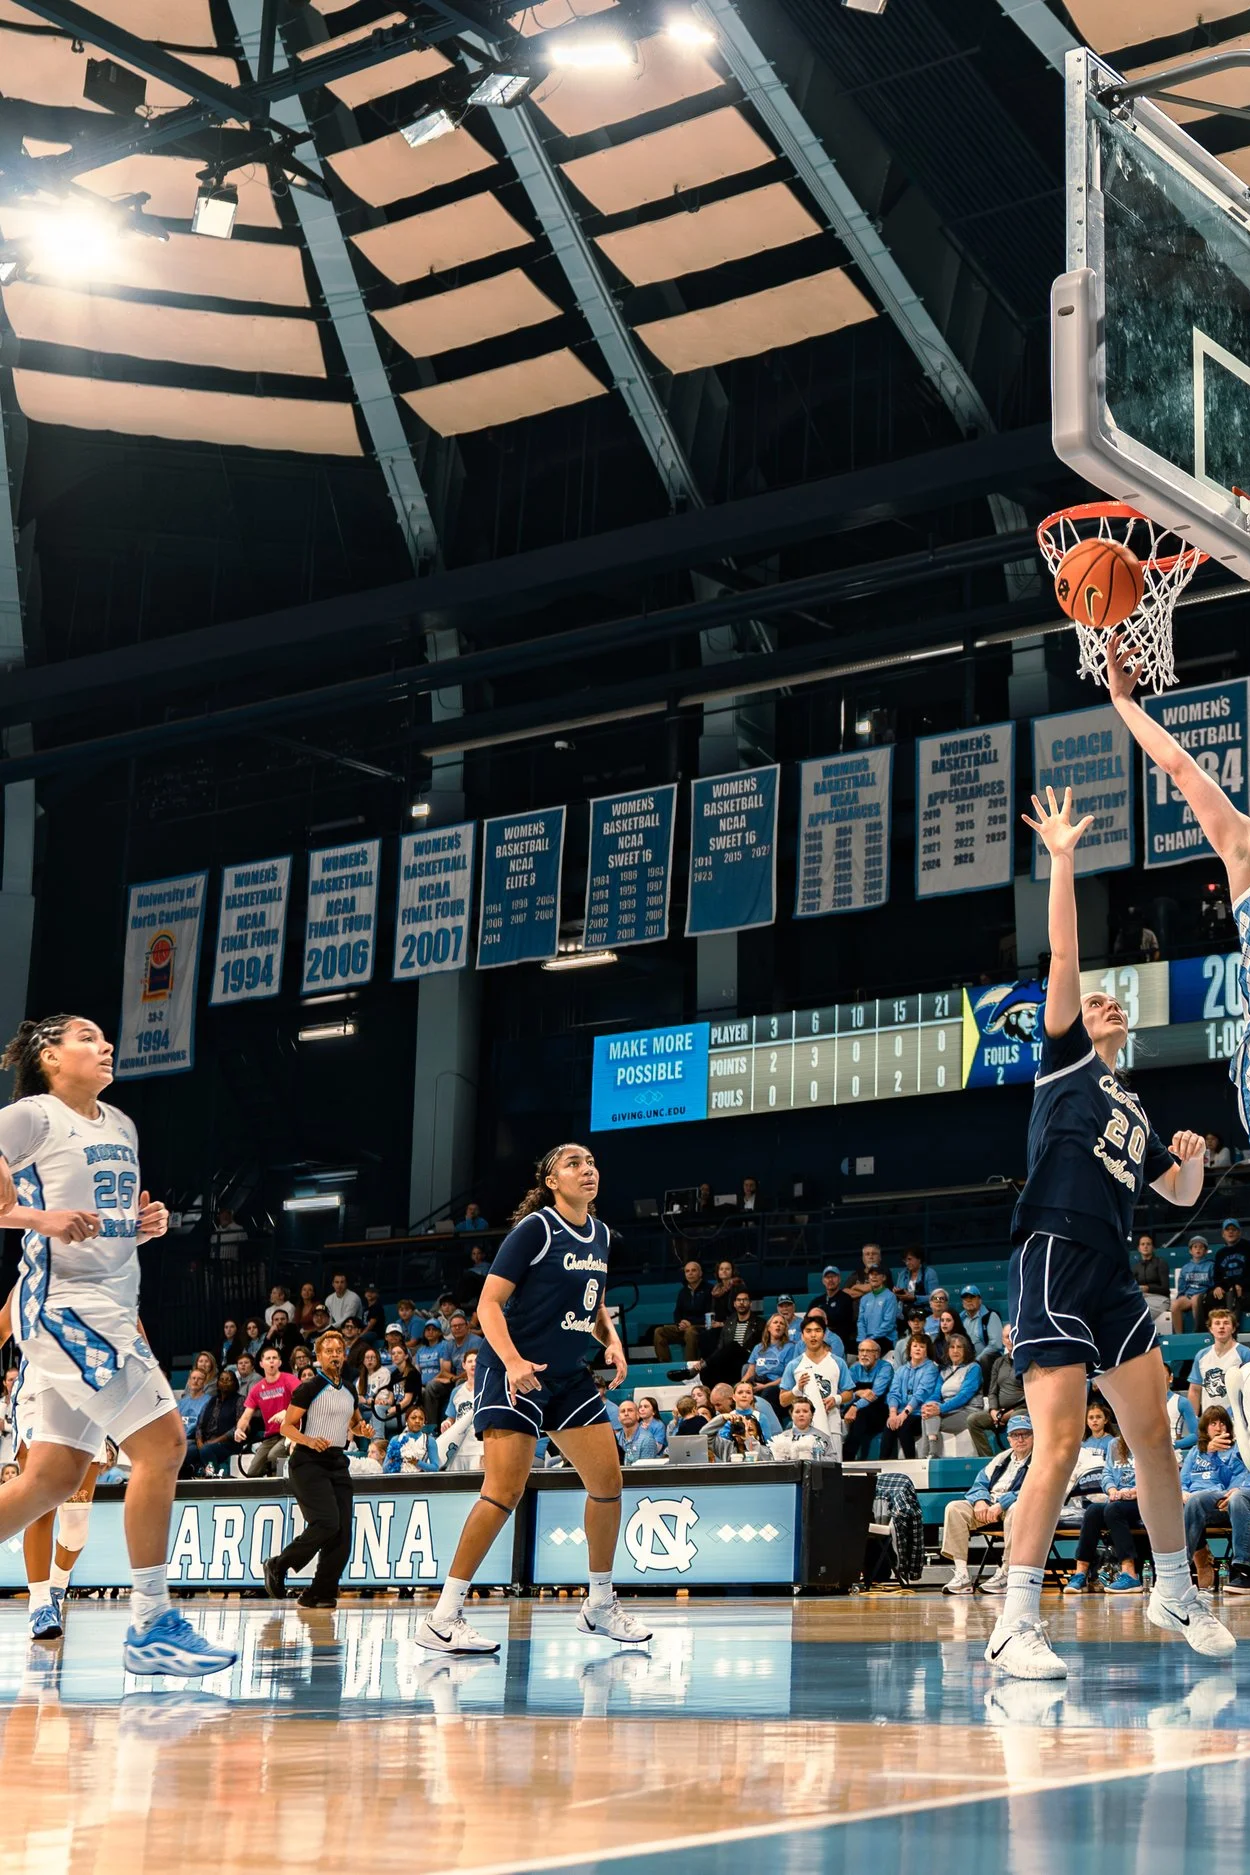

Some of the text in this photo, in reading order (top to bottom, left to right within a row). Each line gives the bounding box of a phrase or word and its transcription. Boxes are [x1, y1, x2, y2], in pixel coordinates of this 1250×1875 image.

[1163, 696, 1231, 727] WOMEN'S
[940, 733, 991, 757] WOMEN'S
[1051, 730, 1112, 762] COACH
[932, 749, 998, 774] BASKETBALL
[712, 775, 757, 798] WOMEN'S
[814, 772, 876, 796] BASKETBALL
[950, 769, 980, 787] NCAA
[612, 795, 654, 817] WOMEN'S
[704, 794, 764, 817] BASKETBALL
[830, 792, 860, 807] NCAA
[927, 780, 1004, 808] APPEARANCES
[1075, 790, 1128, 815] VICTORY
[603, 813, 660, 835] BASKETBALL
[719, 815, 746, 832] NCAA
[808, 803, 881, 827] APPEARANCES
[504, 820, 545, 840] WOMEN'S
[618, 833, 643, 849] NCAA
[709, 831, 756, 851] SWEET 16
[1104, 828, 1129, 844] STATE
[413, 831, 462, 857] WOMEN'S
[495, 838, 549, 858] BASKETBALL
[322, 848, 368, 872] WOMEN'S
[404, 855, 467, 880] BASKETBALL
[509, 856, 534, 873] NCAA
[608, 849, 652, 869] SWEET 16
[234, 864, 278, 888] WOMEN'S
[311, 871, 373, 895] BASKETBALL
[506, 873, 536, 890] ELITE 8
[137, 885, 184, 909] University
[225, 887, 283, 910] BASKETBALL
[419, 880, 451, 901] NCAA
[326, 896, 355, 917] NCAA
[401, 899, 465, 925] FINAL FOUR
[131, 911, 157, 929] North
[236, 911, 265, 931] NCAA
[308, 914, 372, 939] FINAL FOUR
[221, 929, 279, 953] FINAL FOUR
[400, 925, 463, 969] 2007
[306, 939, 370, 983] 2006
[220, 953, 274, 994] 1994
[711, 994, 949, 1045] PLAYER 3 6 10 15 21
[136, 1028, 169, 1054] 1994
[609, 1032, 693, 1059] MAKE MORE
[710, 1047, 818, 1077] POINTS 2 3
[984, 1045, 1019, 1066] FOULS
[617, 1061, 682, 1086] POSSIBLE
[997, 1067, 1004, 1085] 2
[711, 1071, 902, 1109] FOULS 2
[611, 1106, 686, 1122] GIVING.UNC.EDU
[1104, 1108, 1145, 1165] 20
[93, 1171, 137, 1209] 26
[583, 1279, 598, 1311] 6
